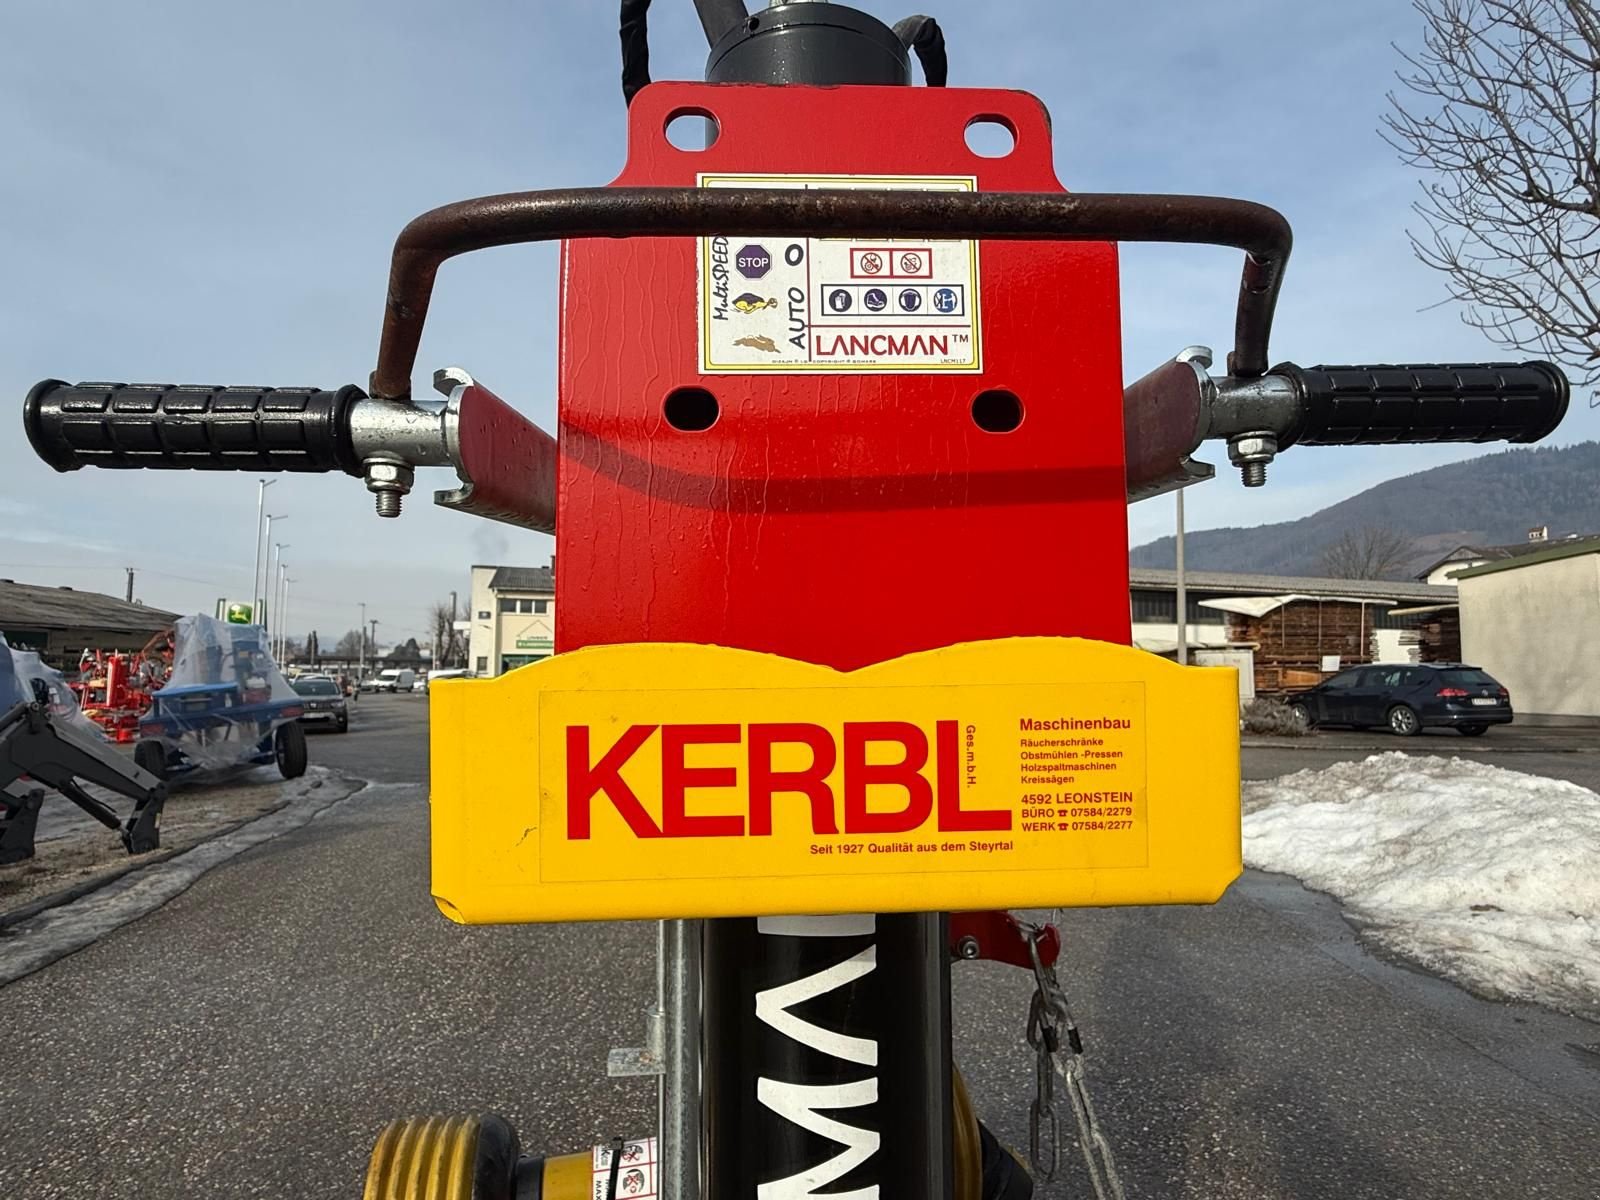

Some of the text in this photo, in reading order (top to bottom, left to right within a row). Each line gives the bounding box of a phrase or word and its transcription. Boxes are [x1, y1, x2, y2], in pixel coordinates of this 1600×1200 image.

[738, 256, 769, 268] STOP
[788, 287, 806, 349] AUTO
[816, 334, 949, 356] LANCMAN
[1020, 717, 1131, 731] Maschinenbau
[1020, 738, 1104, 747] Räucherschränke
[966, 725, 977, 788] Ges.m.b.H.
[1020, 751, 1078, 760] Obstmühlen
[1020, 762, 1117, 773] Holzspaltmaschinen
[566, 720, 1012, 840] KERBL
[1021, 775, 1074, 785] Kreissägen
[1021, 792, 1133, 804] 4592 LEONSTEIN
[1021, 807, 1132, 818] BÜRO 07584/2279
[1022, 820, 1133, 832] WERK 07584/2277
[810, 840, 1013, 854] Seit 1927 Qualität aus dem Steyrtal
